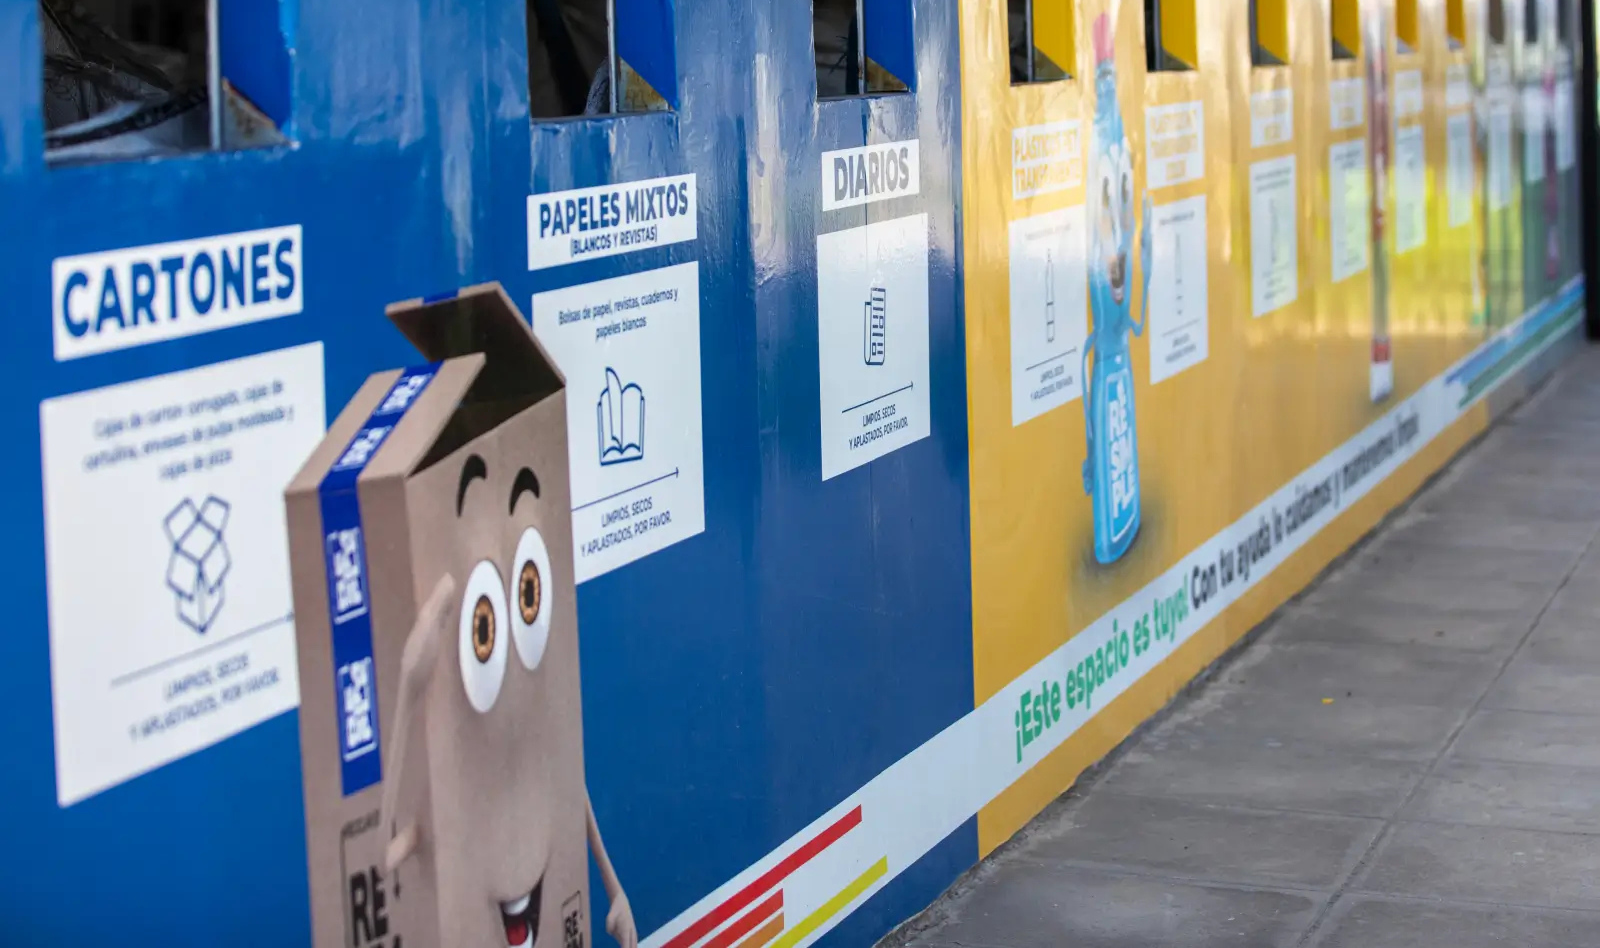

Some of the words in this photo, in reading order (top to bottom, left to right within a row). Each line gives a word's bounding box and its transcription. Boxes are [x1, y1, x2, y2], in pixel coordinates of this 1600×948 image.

[833, 146, 909, 201] DIARIOS
[539, 191, 621, 238] PAPELES
[626, 181, 688, 224] MIXTOS
[570, 233, 612, 258] (BLANCOS
[613, 231, 619, 247] Y
[620, 224, 658, 247] REVISTAS)
[62, 236, 296, 338] CARTONES
[558, 308, 580, 326] Bolsas
[582, 305, 591, 319] de
[592, 300, 613, 320] papel,
[641, 289, 673, 306] cuadernos
[595, 320, 621, 343] papeles
[622, 315, 647, 332] blancos
[882, 403, 896, 419] SECOS
[848, 438, 853, 450] Y
[884, 422, 893, 435] POR
[632, 497, 653, 516] SECOS
[634, 518, 648, 535] POR
[1015, 680, 1061, 764] ¡Este
[1066, 617, 1130, 710] espacio
[1133, 612, 1150, 657] es
[1153, 572, 1189, 643] tuyo!
[1191, 565, 1217, 609] Con
[1220, 548, 1234, 588] tu
[350, 865, 389, 947] RE
